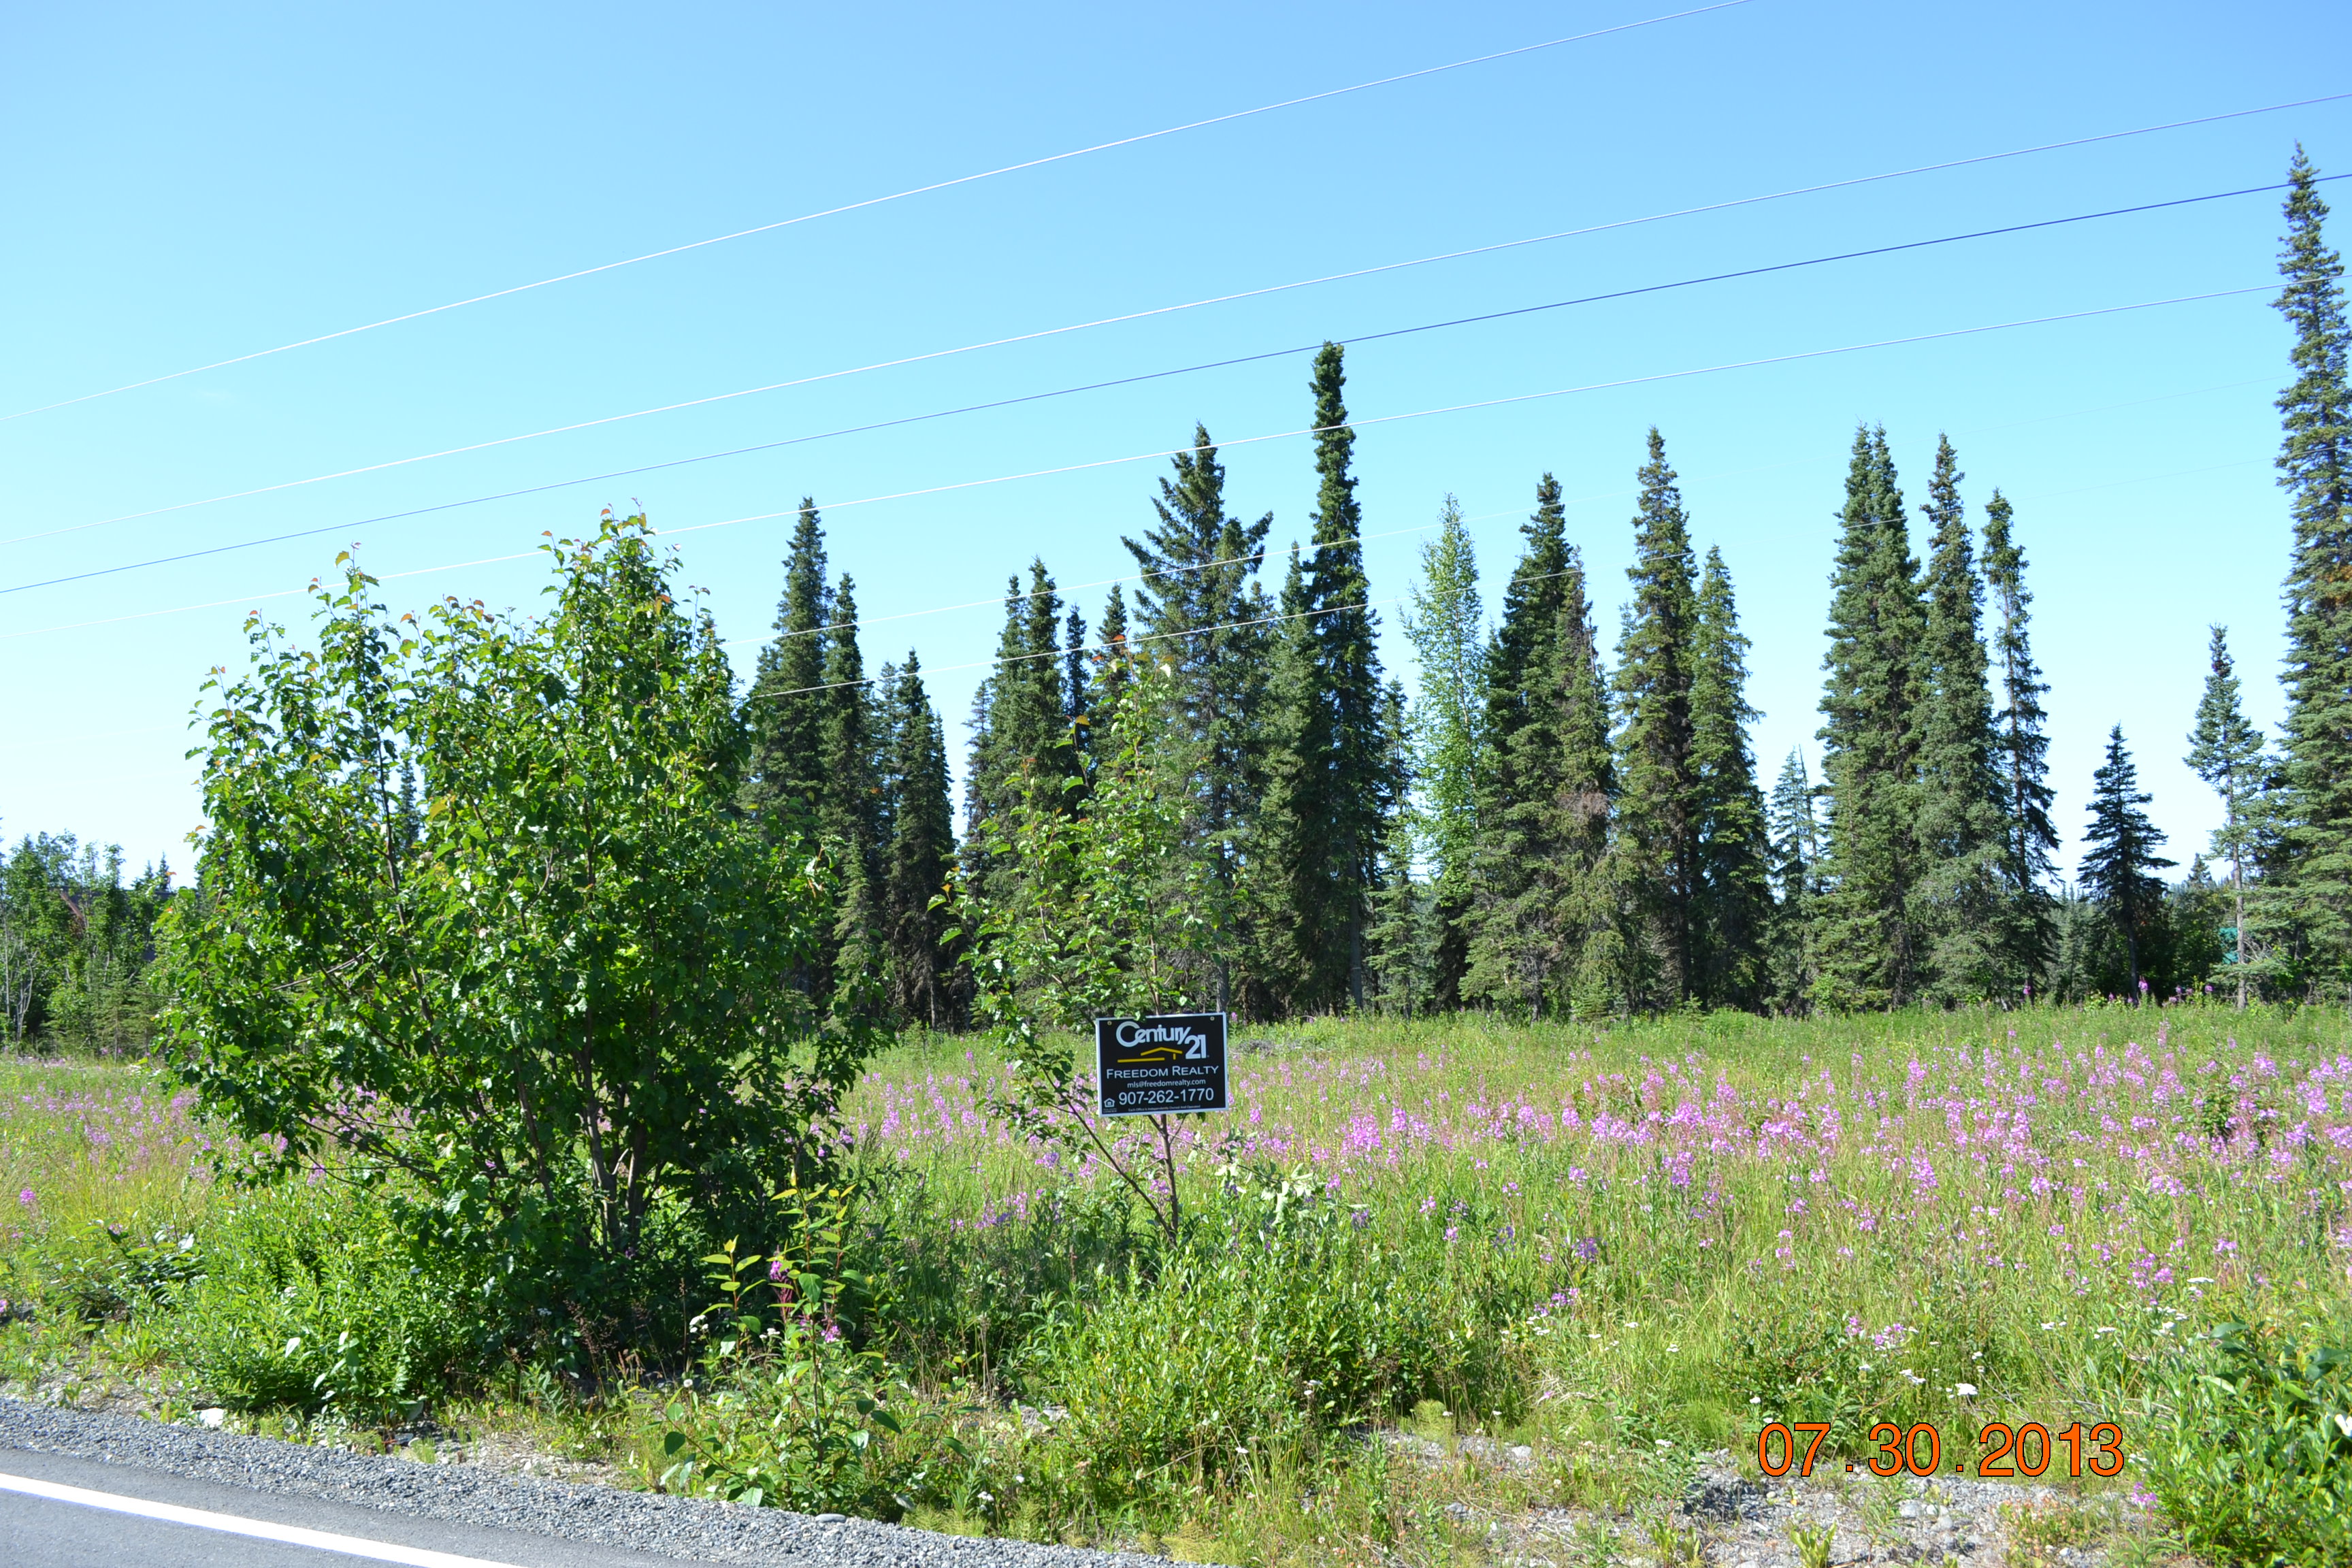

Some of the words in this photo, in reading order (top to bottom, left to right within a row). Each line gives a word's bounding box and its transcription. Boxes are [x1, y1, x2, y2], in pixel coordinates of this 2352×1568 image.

[1184, 1034, 1207, 1059] 21
[1106, 1068, 1169, 1079] FREEDOM
[1172, 1065, 1219, 1076] REALTY
[1127, 1078, 1206, 1088] mls@freedomrealty.com
[1118, 1088, 1214, 1105] 907-262-1770
